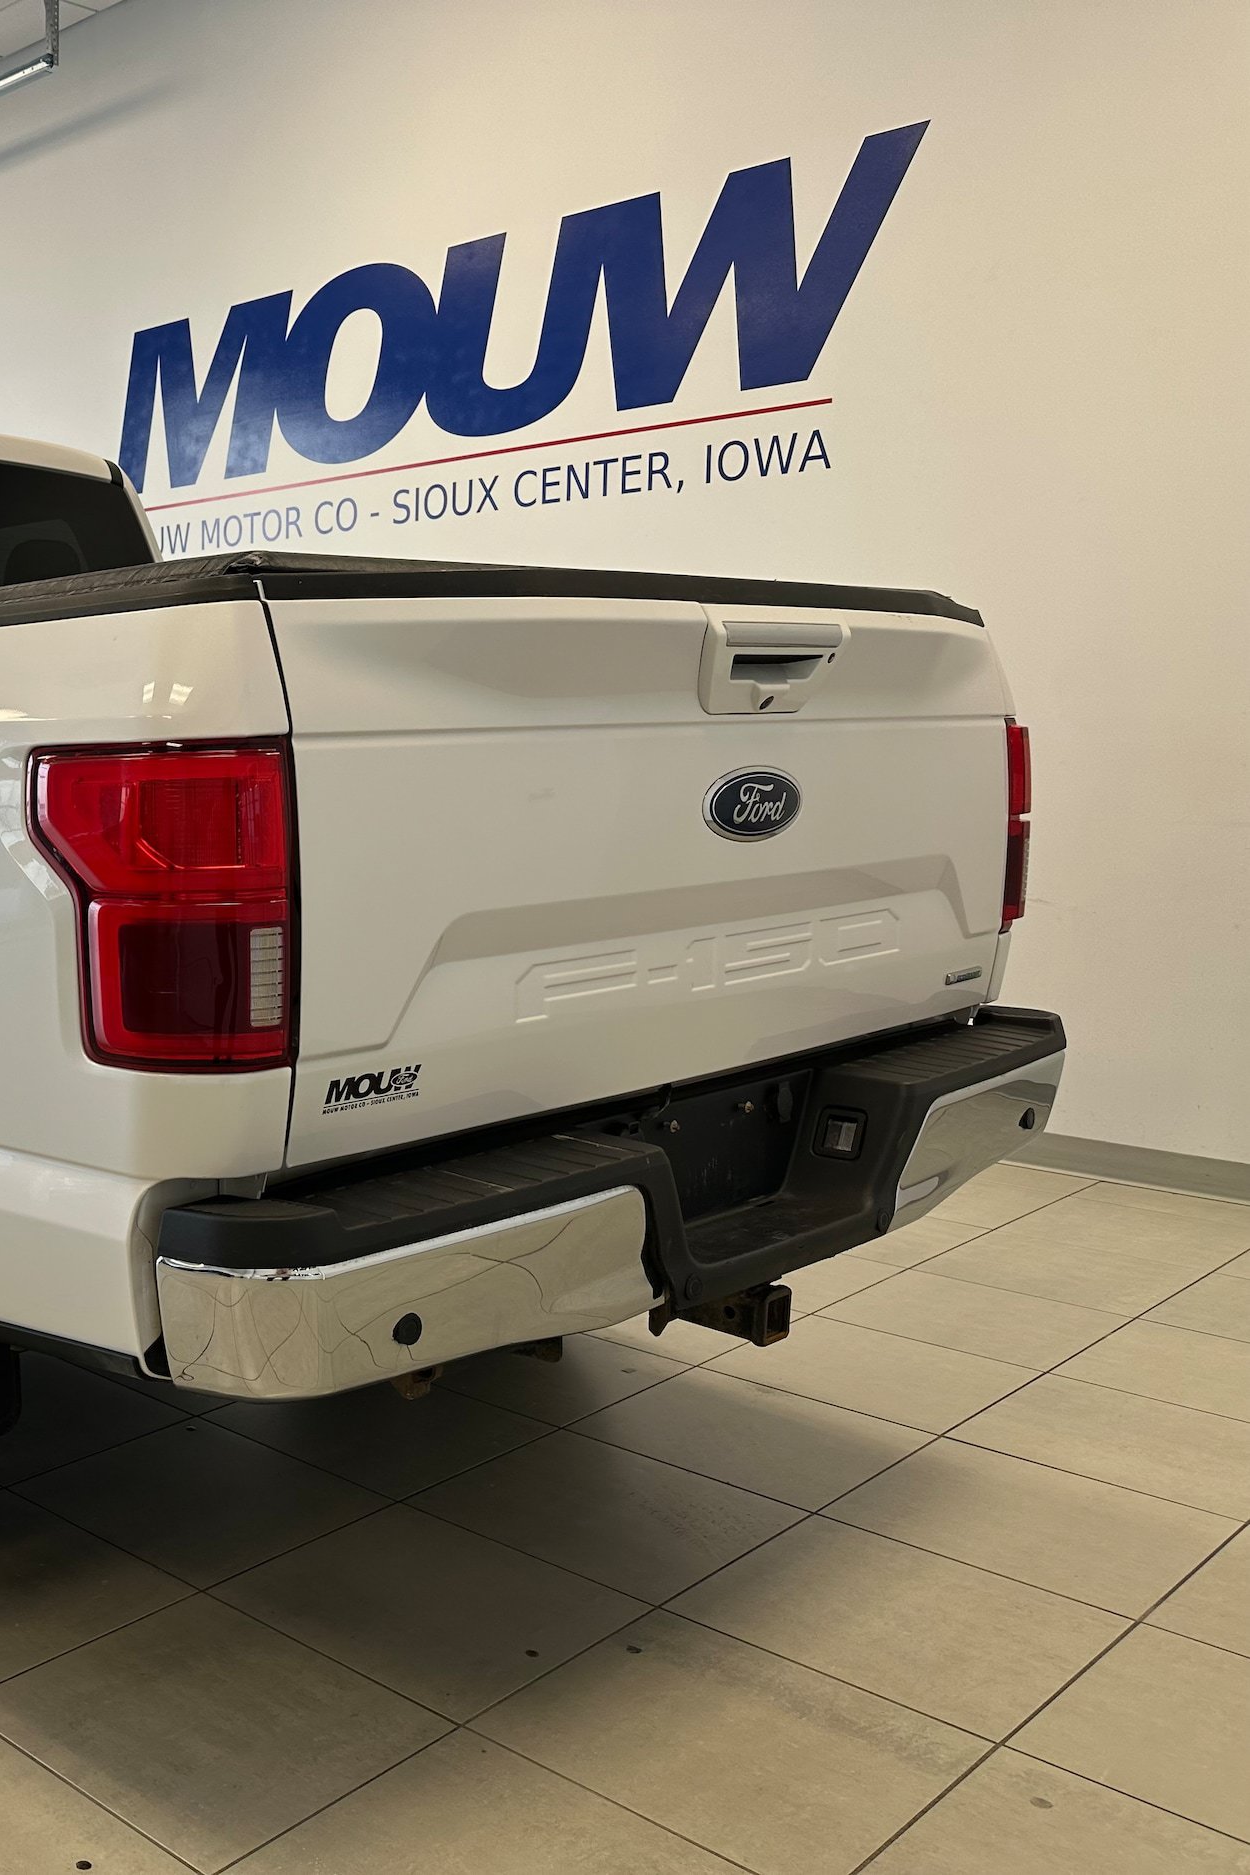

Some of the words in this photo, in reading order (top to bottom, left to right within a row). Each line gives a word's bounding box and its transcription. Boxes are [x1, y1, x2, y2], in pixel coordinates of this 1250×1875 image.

[118, 120, 930, 494] MOUW
[200, 506, 303, 550] MOTOR
[314, 498, 358, 535] CO
[392, 475, 499, 524] SIOUX
[513, 451, 684, 507] CENTER,
[705, 429, 831, 484] IOWA
[733, 783, 787, 824] Ford
[514, 908, 900, 1024] F-150
